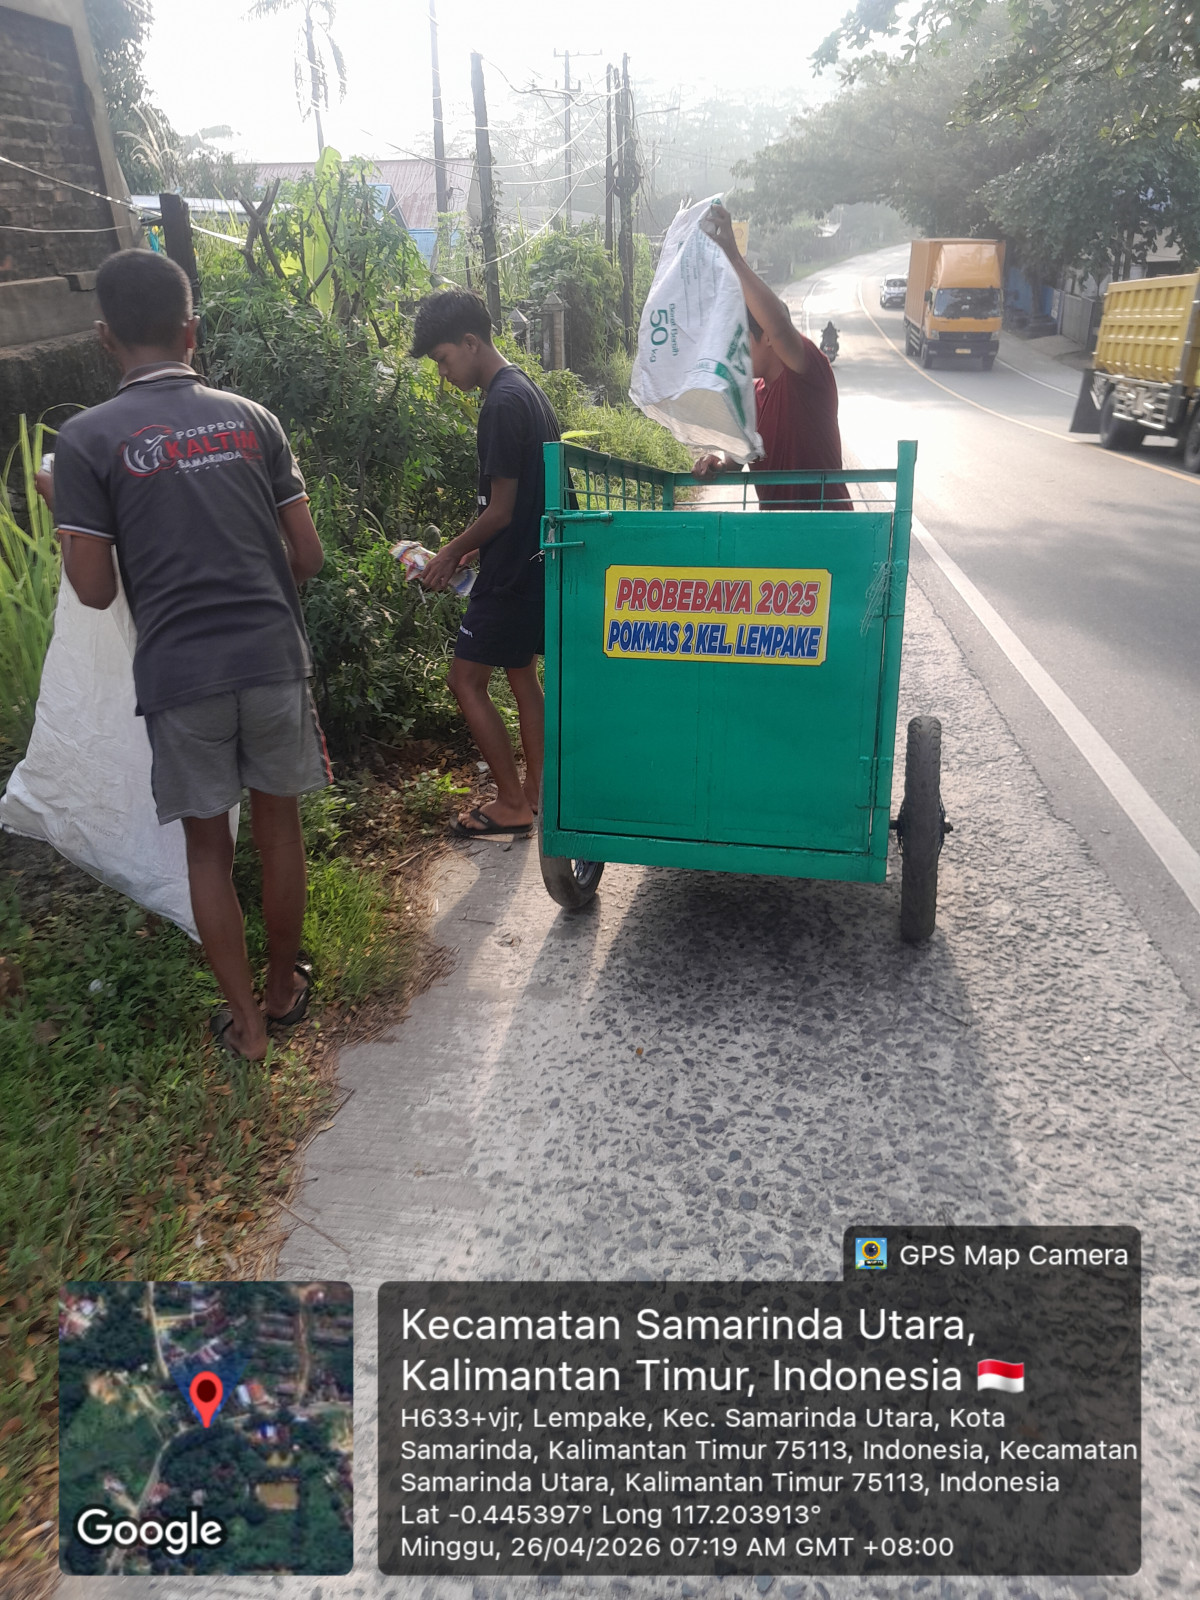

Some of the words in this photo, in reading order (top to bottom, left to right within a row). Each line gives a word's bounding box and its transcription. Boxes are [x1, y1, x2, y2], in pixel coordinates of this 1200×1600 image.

[650, 309, 669, 346] 50
[165, 430, 259, 459] KALTIM
[175, 420, 246, 440] PORPROV
[177, 450, 244, 469] SAMARINDA
[615, 578, 752, 614] PROBEBAYA
[755, 580, 821, 616] 2025
[607, 619, 681, 653] POKMAS
[680, 622, 695, 654] 2
[694, 623, 734, 656] KEL.
[734, 624, 823, 659] LEMPAKE
